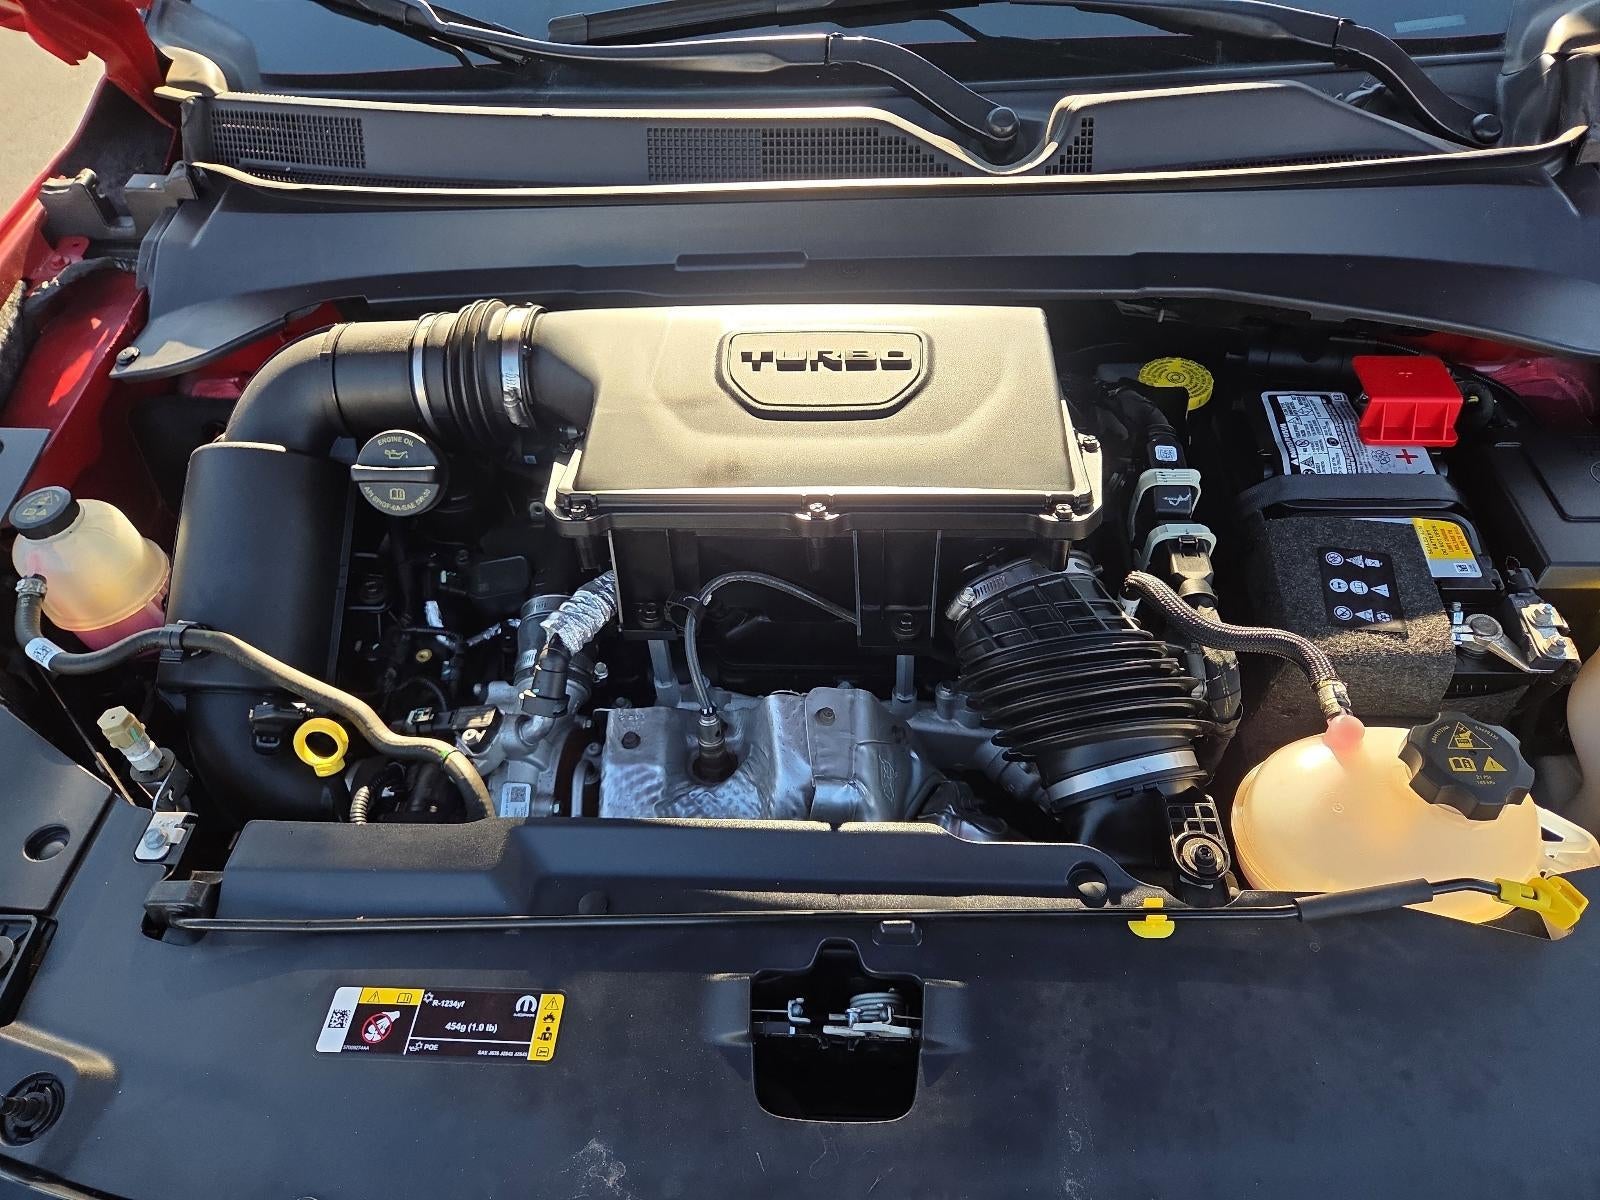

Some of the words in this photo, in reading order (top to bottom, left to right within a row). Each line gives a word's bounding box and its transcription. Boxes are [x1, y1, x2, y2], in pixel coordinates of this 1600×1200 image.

[741, 350, 912, 371] TURBO
[378, 436, 402, 446] ENGINE
[403, 437, 414, 447] OIL
[432, 999, 465, 1009] R-1234yf
[445, 1022, 466, 1032] 454g
[468, 1023, 484, 1033] (1.0
[485, 1024, 497, 1033] lb)
